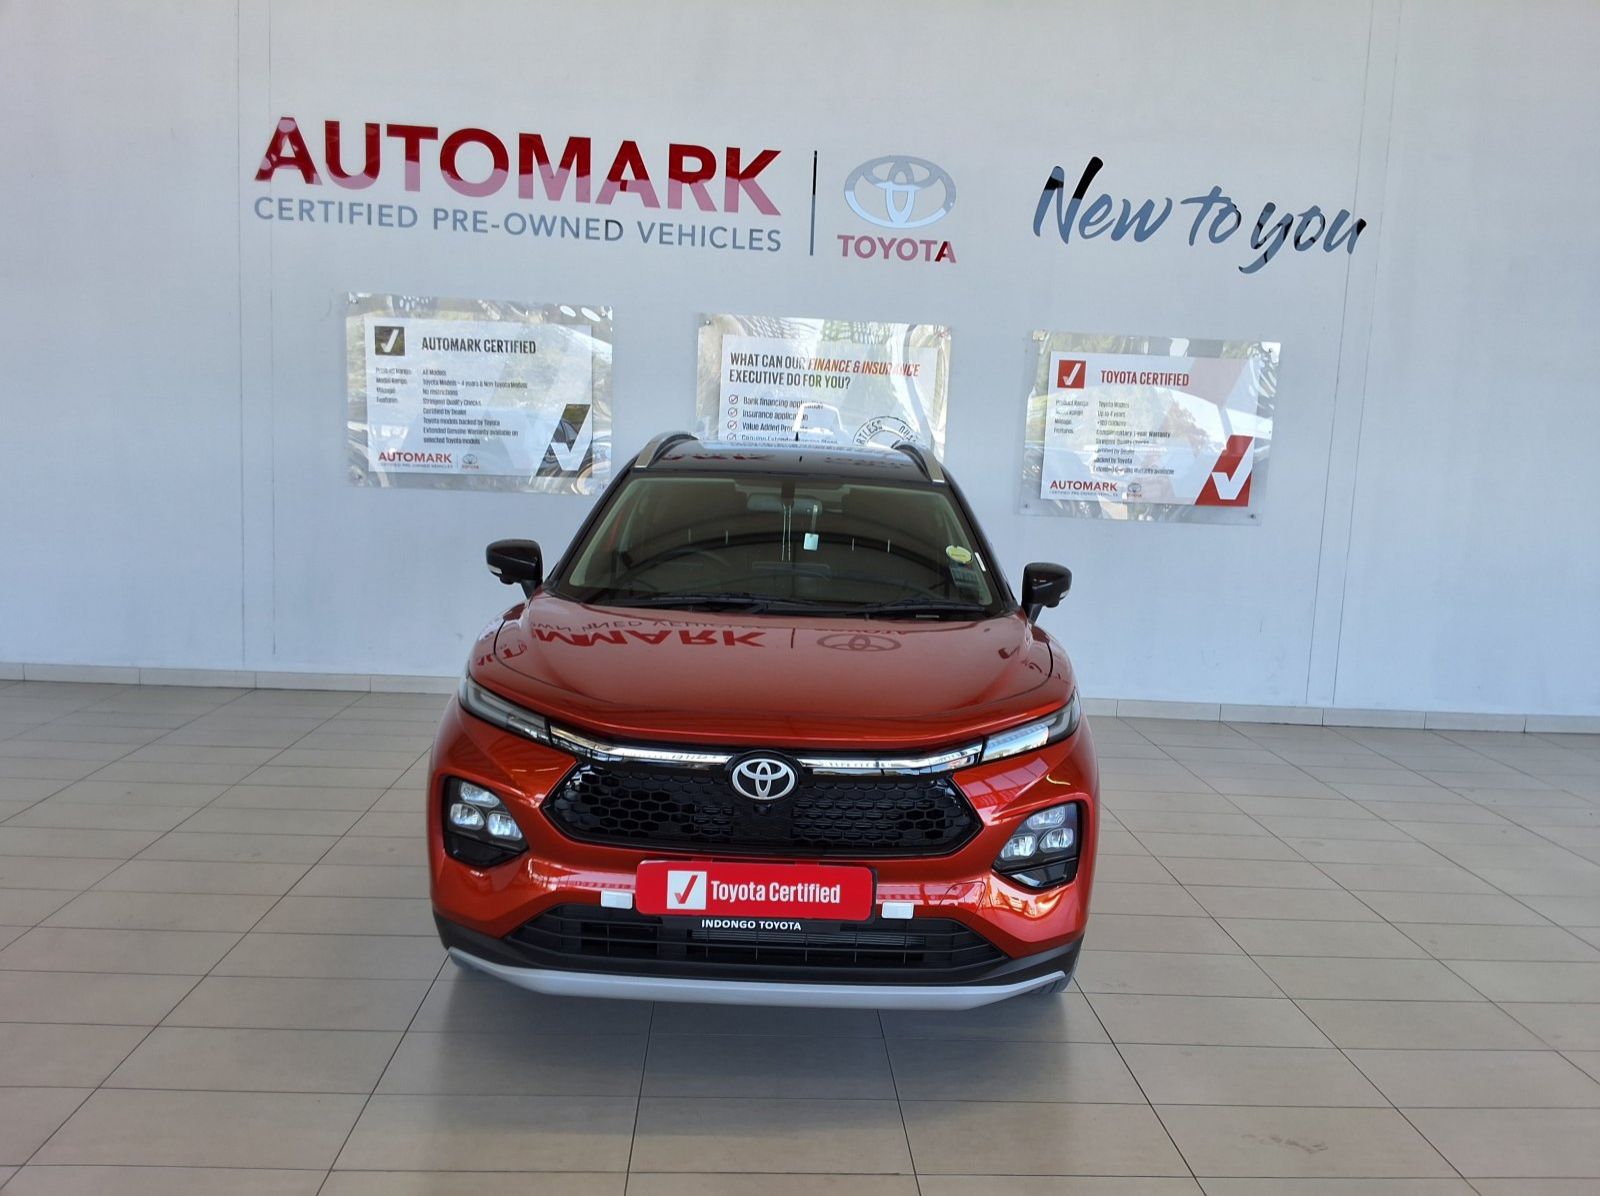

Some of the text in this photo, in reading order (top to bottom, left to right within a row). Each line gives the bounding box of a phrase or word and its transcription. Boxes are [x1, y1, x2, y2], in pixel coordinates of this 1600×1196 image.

[254, 116, 782, 217] AUTOMARK
[254, 196, 782, 253] CERTIFIED PRE-OWNED VEHICLES
[1033, 156, 1368, 275] New to you
[836, 233, 957, 264] TOYOTA
[421, 336, 537, 354] AUTOMARK CERTIFIED
[730, 352, 760, 367] WHAT
[761, 354, 783, 369] CAN
[785, 356, 805, 370] OUR
[808, 358, 852, 373] FINANCE
[853, 360, 861, 373] &
[729, 369, 851, 389] EXECUTIVE DO FOR YOU?
[1100, 370, 1190, 387] TOYOTA CERTIFIED
[743, 396, 759, 405] Bank
[759, 396, 789, 409] financing
[742, 409, 809, 421] Insurance applicaon
[742, 422, 760, 431] Value
[378, 451, 453, 464] AUTOMARK
[1050, 479, 1118, 492] AUTOMARK
[710, 880, 841, 904] Toyota Certified
[701, 919, 802, 931] INDONGO TOYOTA
